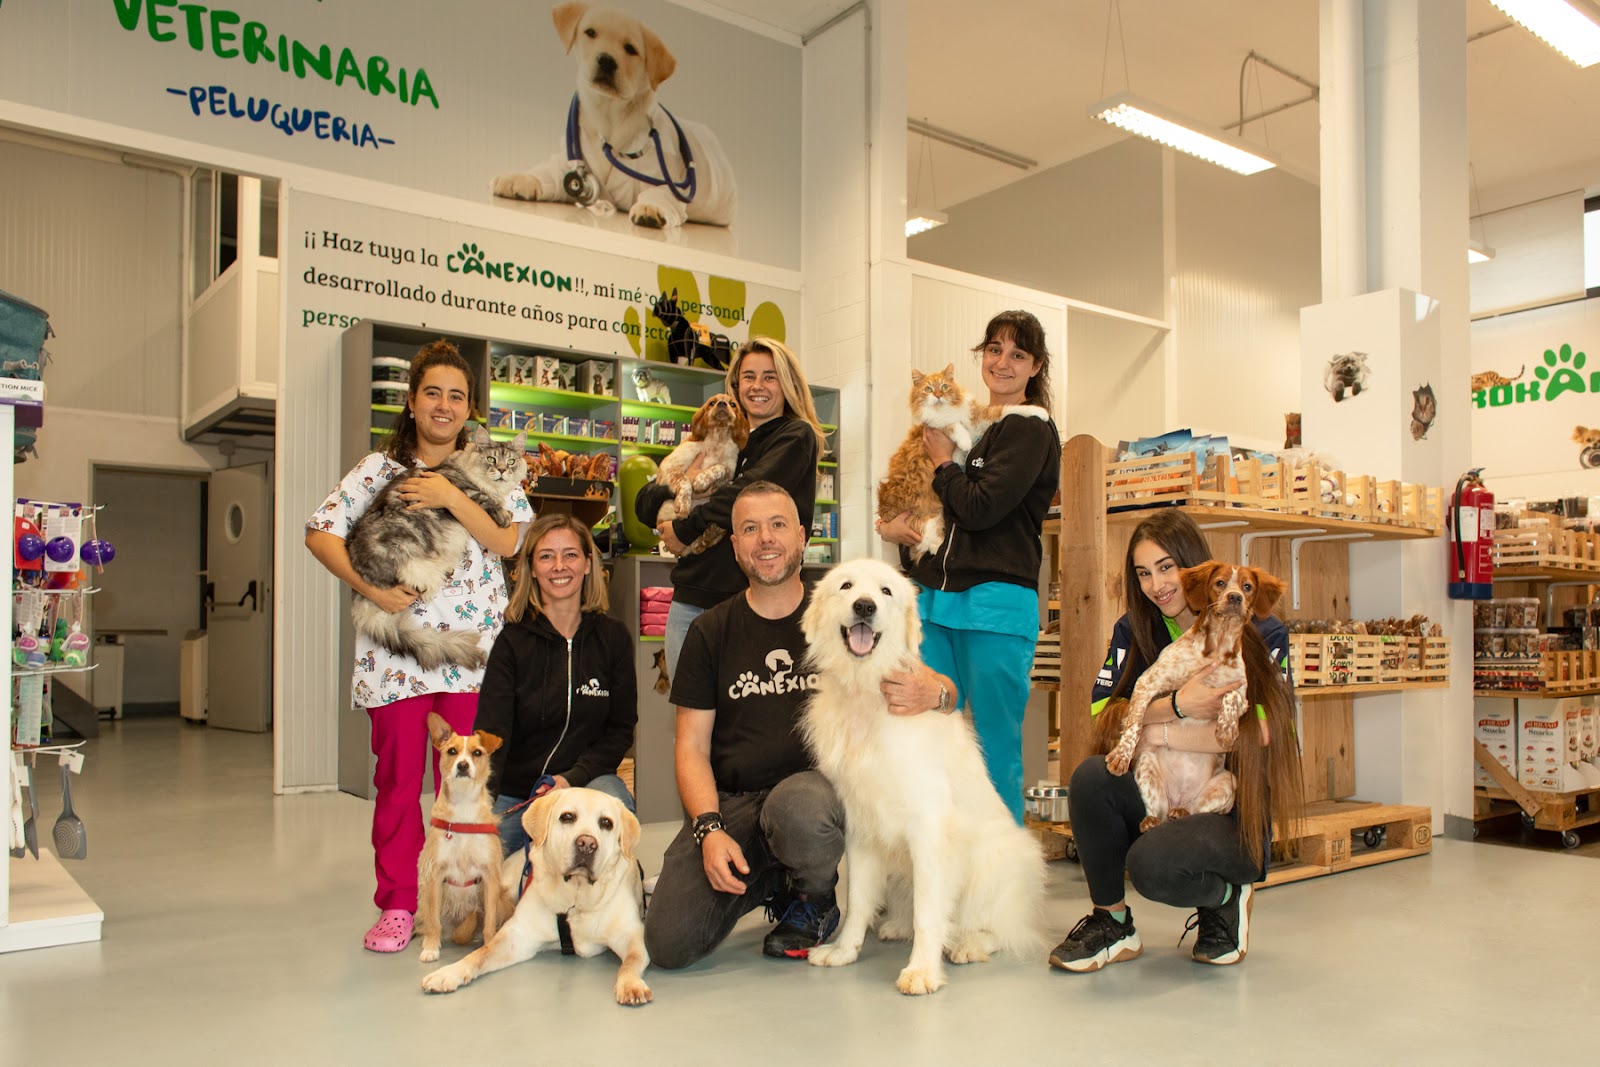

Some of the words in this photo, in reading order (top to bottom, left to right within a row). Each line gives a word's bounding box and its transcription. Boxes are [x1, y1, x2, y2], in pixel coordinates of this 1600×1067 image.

[113, 0, 440, 109] VETERINARIA
[303, 266, 436, 304] desarrollado
[441, 290, 516, 316] durante
[521, 305, 563, 324] años
[568, 314, 608, 332] para
[322, 231, 363, 253] Haz
[369, 241, 415, 264] tuya
[421, 248, 439, 267] la
[593, 283, 615, 298] mi
[681, 299, 750, 325] personal,
[302, 309, 361, 328] perso
[729, 671, 820, 700] CANEXIO
